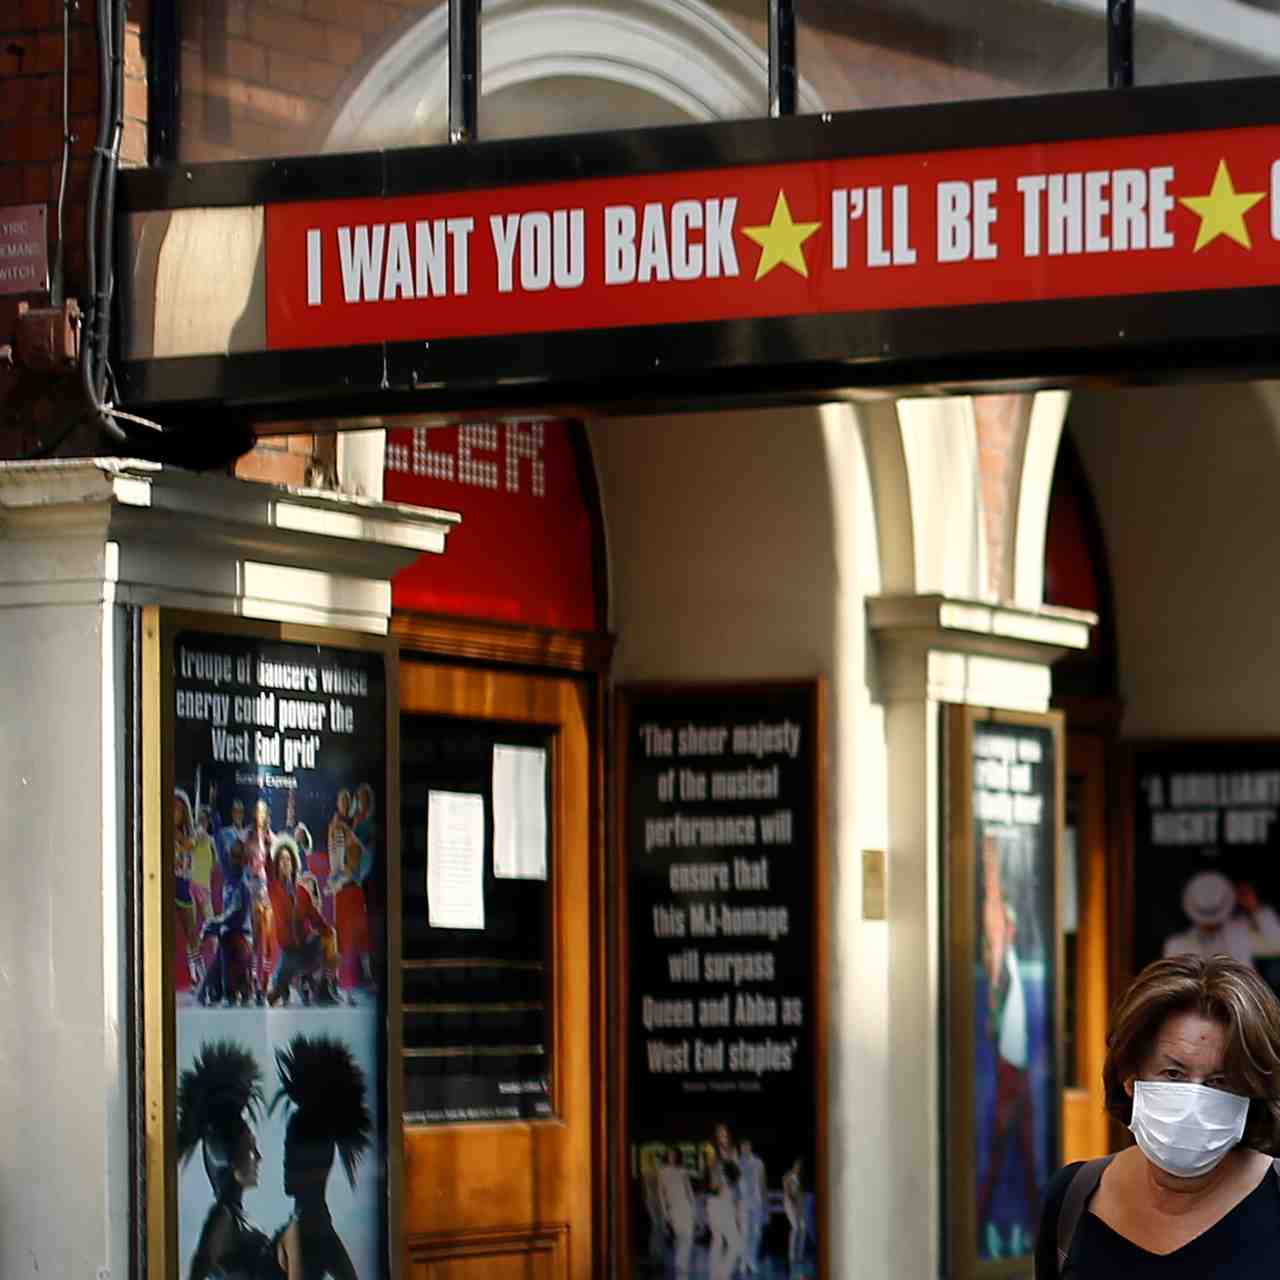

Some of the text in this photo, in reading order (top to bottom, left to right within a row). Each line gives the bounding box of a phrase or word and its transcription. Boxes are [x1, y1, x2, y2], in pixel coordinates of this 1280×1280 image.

[831, 166, 1175, 269] I'LL BE THERE
[307, 197, 739, 305] I WANT YOU BACK
[181, 645, 232, 686] troupe
[236, 652, 251, 686] of
[320, 662, 368, 697] whose
[176, 689, 354, 734] energy could power the
[211, 728, 250, 763] West
[254, 731, 280, 768] End
[678, 724, 729, 756] sheer
[732, 720, 800, 759] majesty
[657, 764, 779, 802] of the musical
[645, 809, 793, 853] performance will
[669, 856, 769, 892] ensure that
[652, 904, 686, 937] this
[668, 949, 775, 986] will surpass
[642, 993, 803, 1031] Queen and Abba as
[647, 1040, 689, 1073] West
[694, 1039, 724, 1073] End
